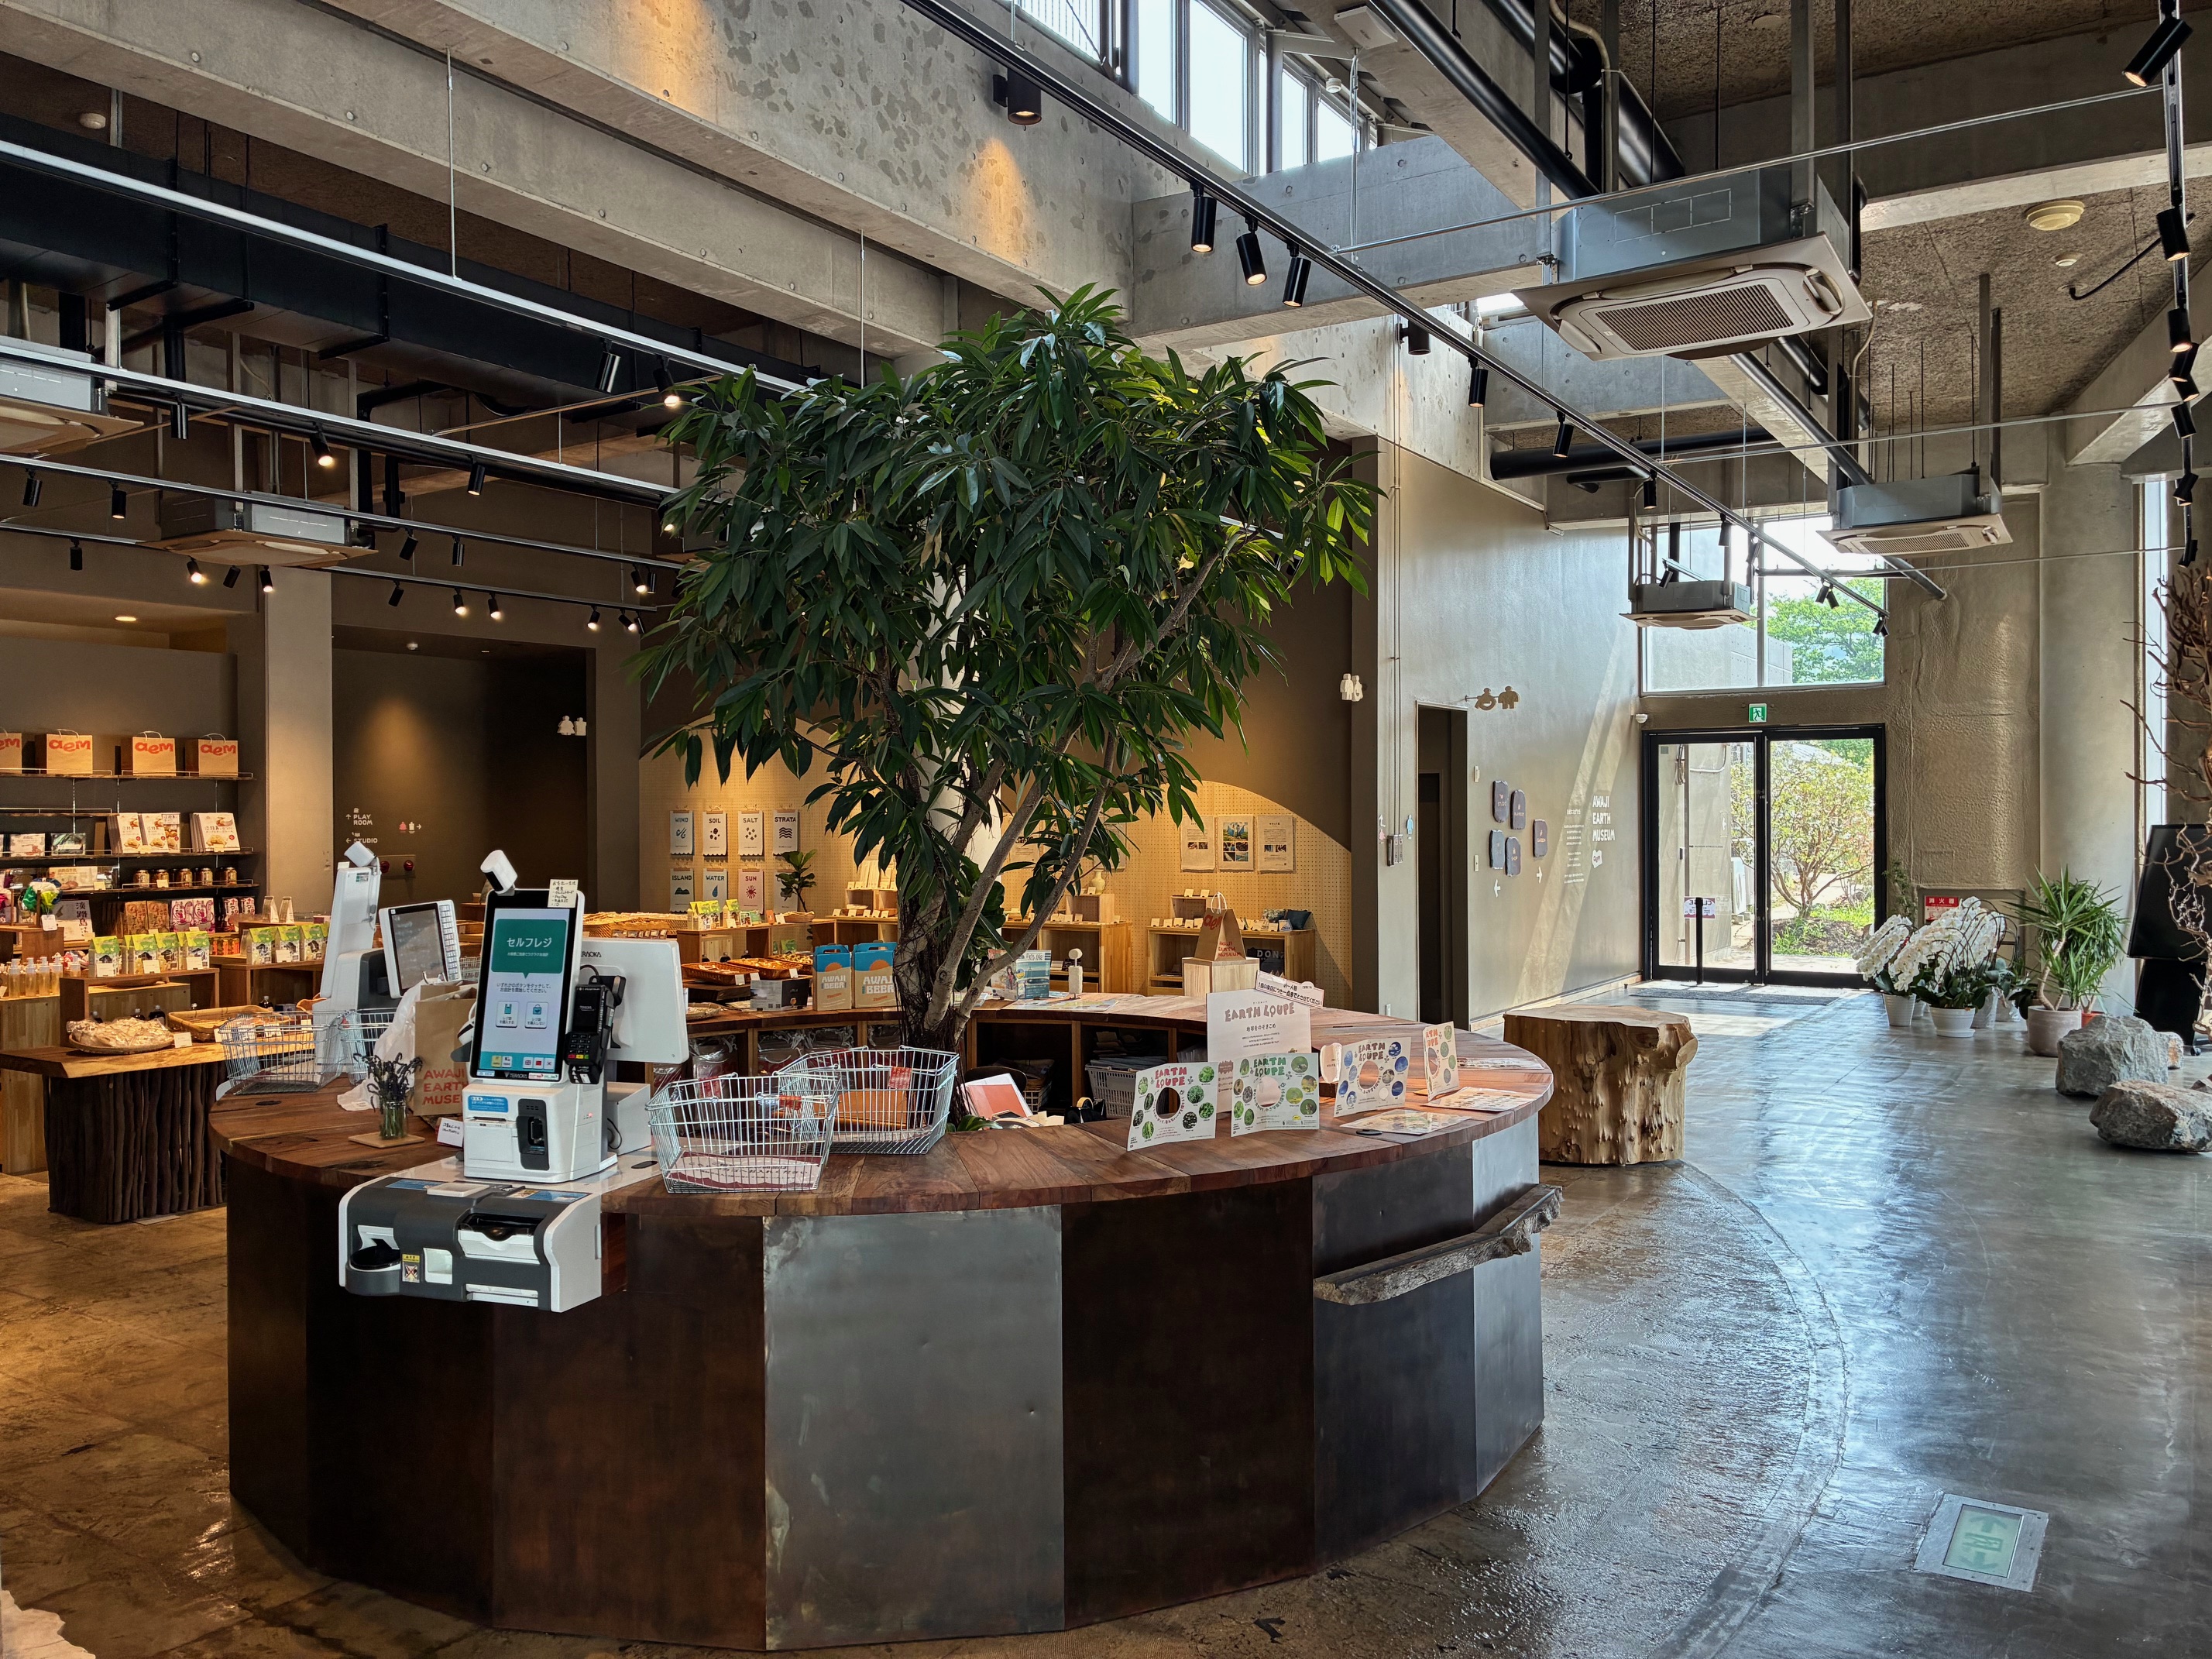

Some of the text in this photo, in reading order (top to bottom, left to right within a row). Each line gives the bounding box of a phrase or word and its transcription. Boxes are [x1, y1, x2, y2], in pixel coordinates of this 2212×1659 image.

[49, 739, 91, 752] aem
[135, 742, 173, 754] aem
[200, 744, 236, 756] aem
[1592, 795, 1609, 808] AWAJI
[1592, 812, 1611, 825] EARTH
[1592, 829, 1616, 842] MUSEUM
[507, 937, 552, 948] セルフレジ
[862, 976, 894, 985] AWAJ
[1224, 1002, 1295, 1022] EARTH LOUPE
[1358, 1042, 1386, 1053] EARTH
[1253, 1057, 1286, 1068] EARTH
[1359, 1051, 1384, 1062] LOUPE
[423, 1068, 465, 1080] AWAJI
[1155, 1066, 1187, 1080] EARTH
[1255, 1066, 1285, 1077] LOUPE
[1156, 1077, 1186, 1089] LOUPE
[423, 1094, 463, 1106] MUSE
